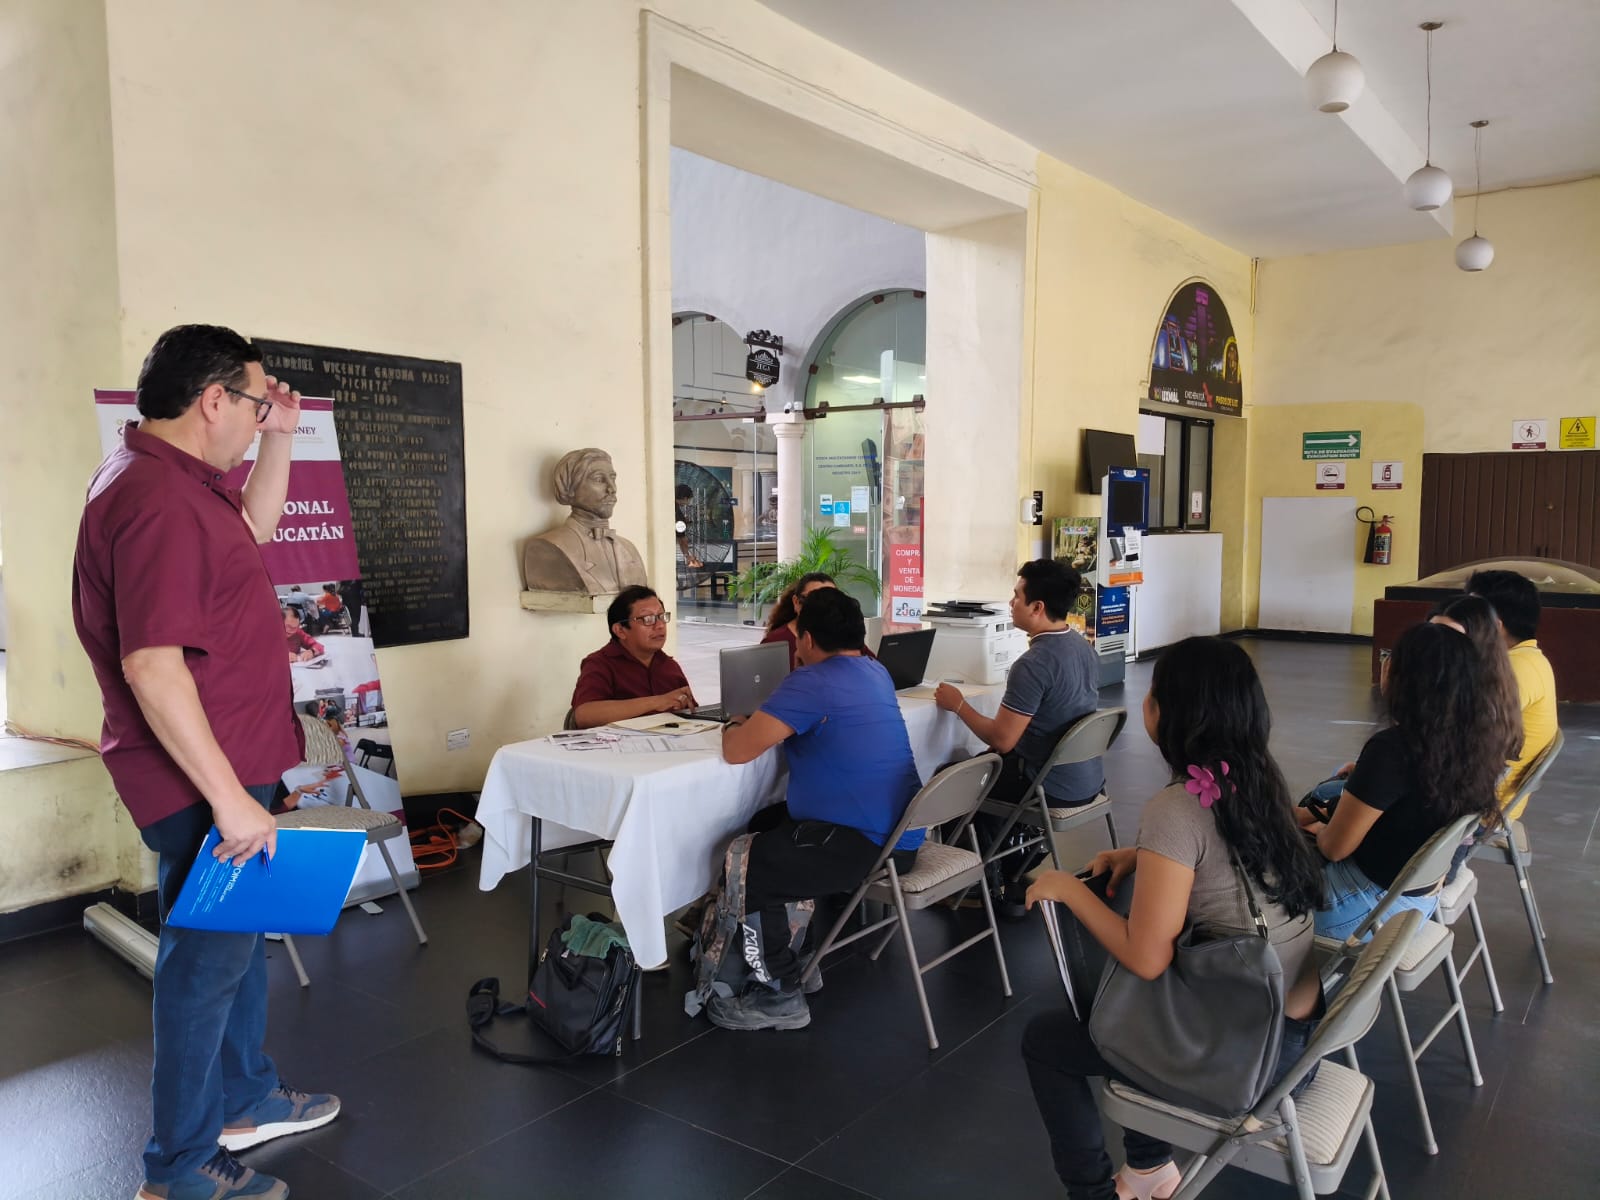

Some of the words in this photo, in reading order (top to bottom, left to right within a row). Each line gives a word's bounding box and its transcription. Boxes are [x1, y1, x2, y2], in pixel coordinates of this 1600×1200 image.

[267, 354, 314, 372] GABRIEL
[323, 360, 367, 377] VICENTE
[422, 371, 450, 385] PASOS
[281, 500, 334, 515] ONAL
[272, 522, 344, 542] UCATÁN
[895, 549, 920, 557] COMPR
[907, 558, 912, 566] Y
[898, 567, 920, 575] VENTA
